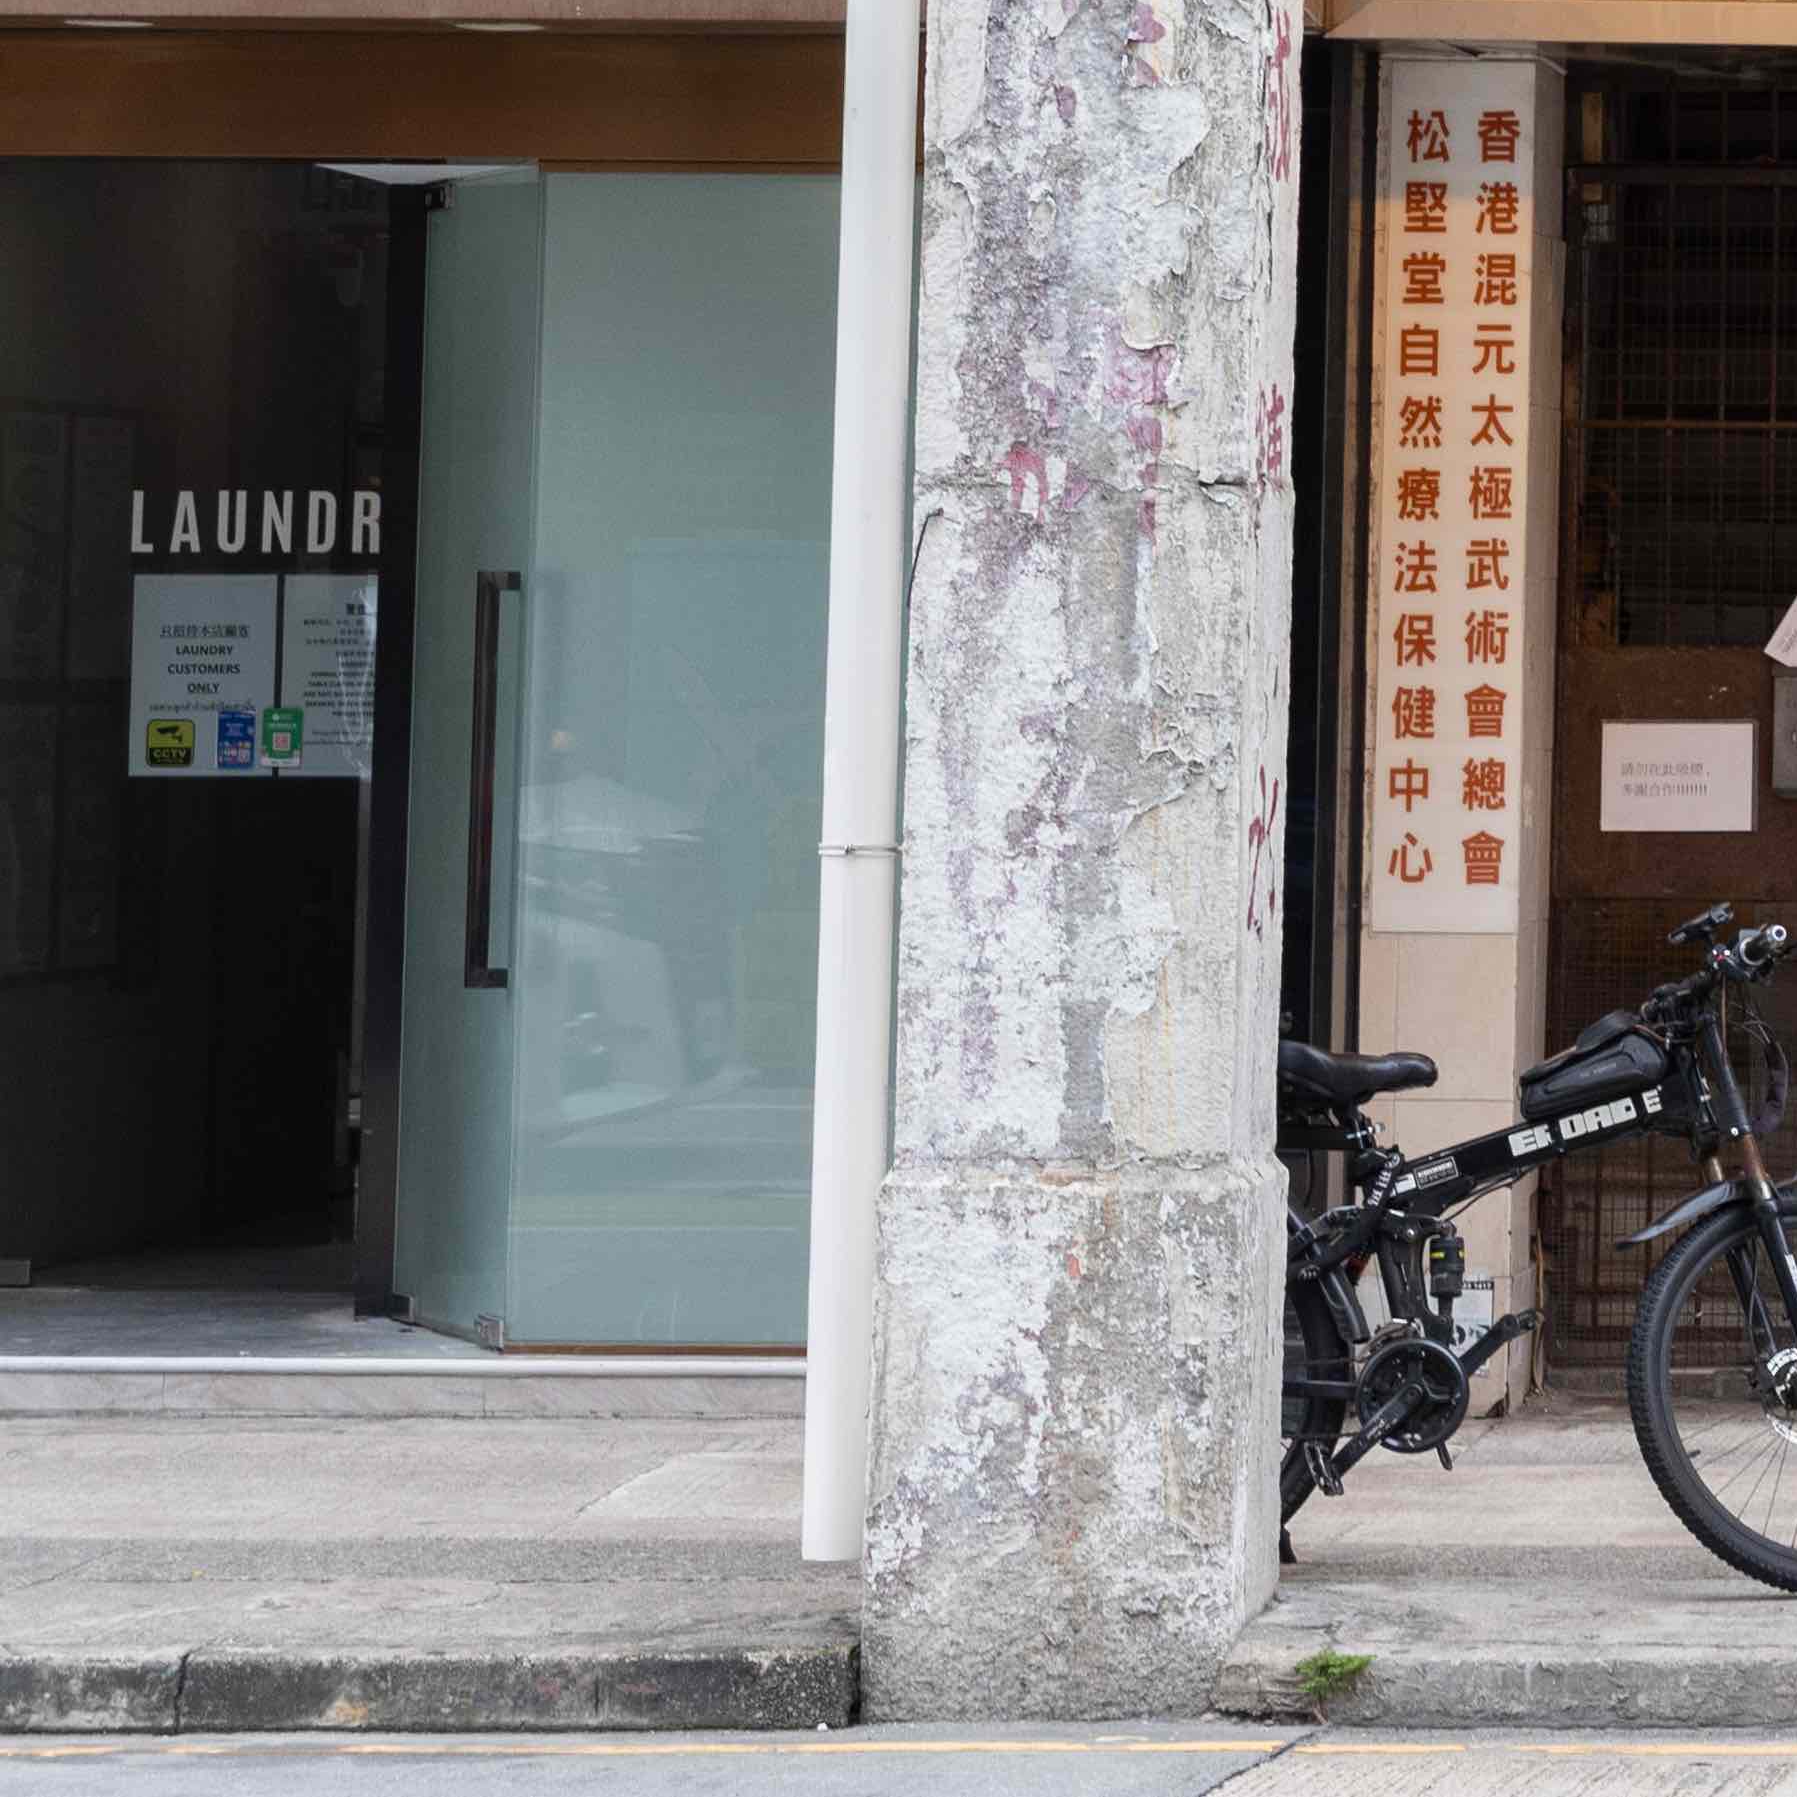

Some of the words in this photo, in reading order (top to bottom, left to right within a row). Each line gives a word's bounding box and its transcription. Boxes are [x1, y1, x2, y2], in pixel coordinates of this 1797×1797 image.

[1387, 109, 1450, 884] 松堅堂自然療法保健中心
[1461, 110, 1520, 885] 香港混元太極武術會總會
[130, 489, 382, 554] LAUNDR
[167, 663, 241, 675] CUSTOMERS
[175, 644, 234, 656] LAUNDRY
[186, 682, 221, 694] ONLY
